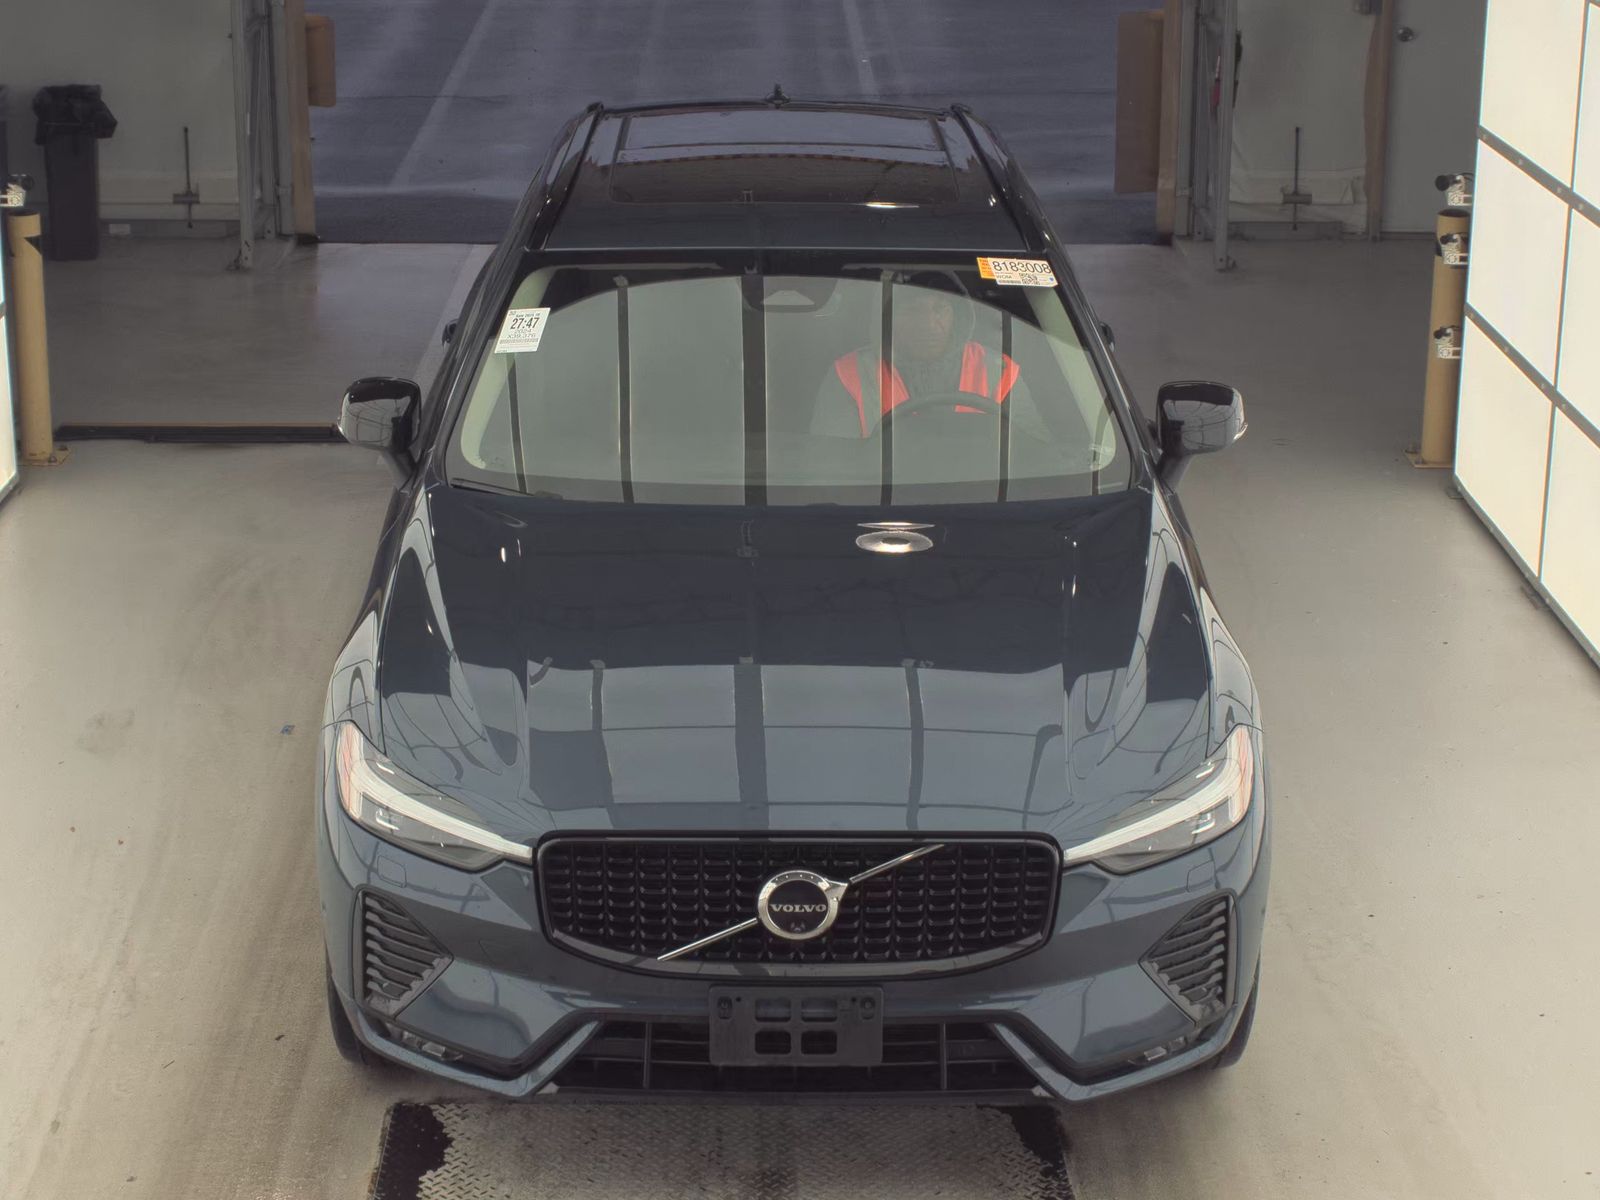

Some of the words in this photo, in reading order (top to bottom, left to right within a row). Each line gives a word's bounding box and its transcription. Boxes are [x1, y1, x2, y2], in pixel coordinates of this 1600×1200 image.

[992, 260, 1052, 274] 8183008
[510, 317, 540, 330] 27:47
[769, 903, 827, 913] VOLVO
